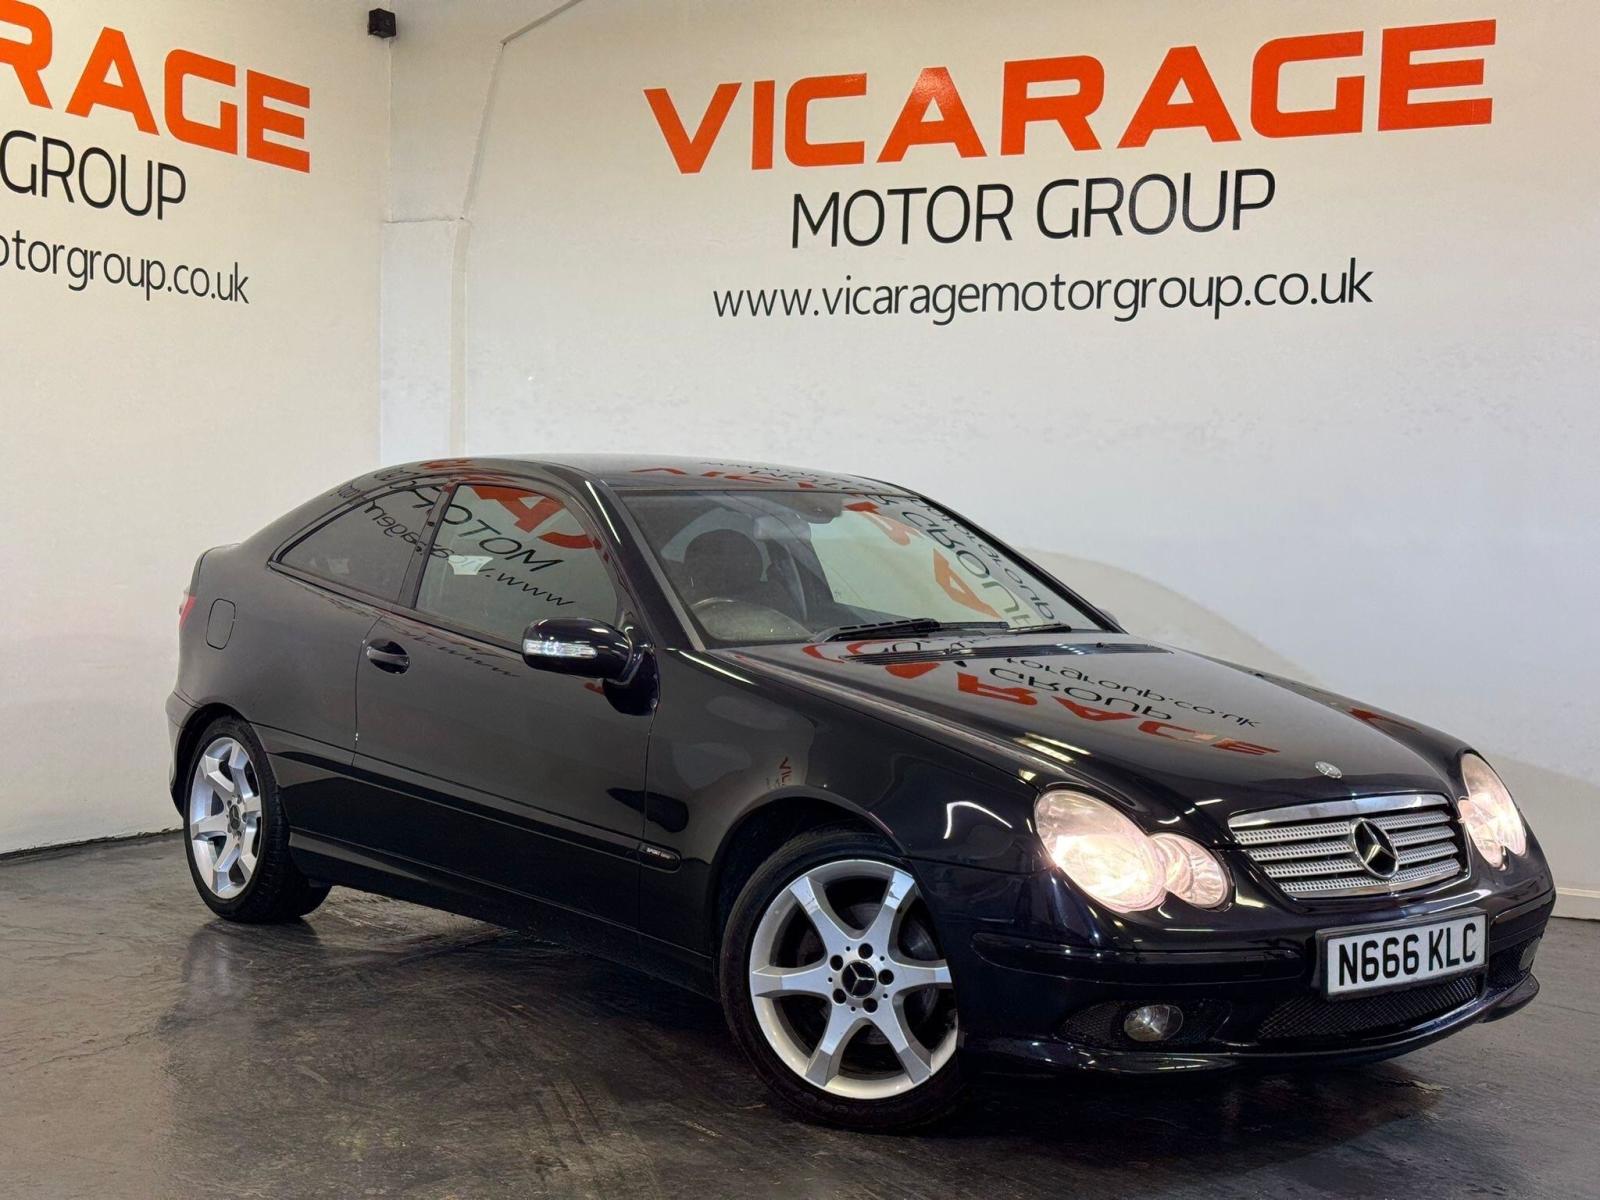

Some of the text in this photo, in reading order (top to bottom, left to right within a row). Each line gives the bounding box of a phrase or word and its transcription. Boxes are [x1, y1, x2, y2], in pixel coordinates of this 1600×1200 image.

[644, 19, 1497, 174] VICARAGE
[0, 130, 186, 220] GROUP
[792, 168, 1276, 249] MOTOR GROUP
[713, 257, 1374, 326] www.vicaragemotorgroup.co.uk
[1338, 922, 1477, 987] N666 KLC
